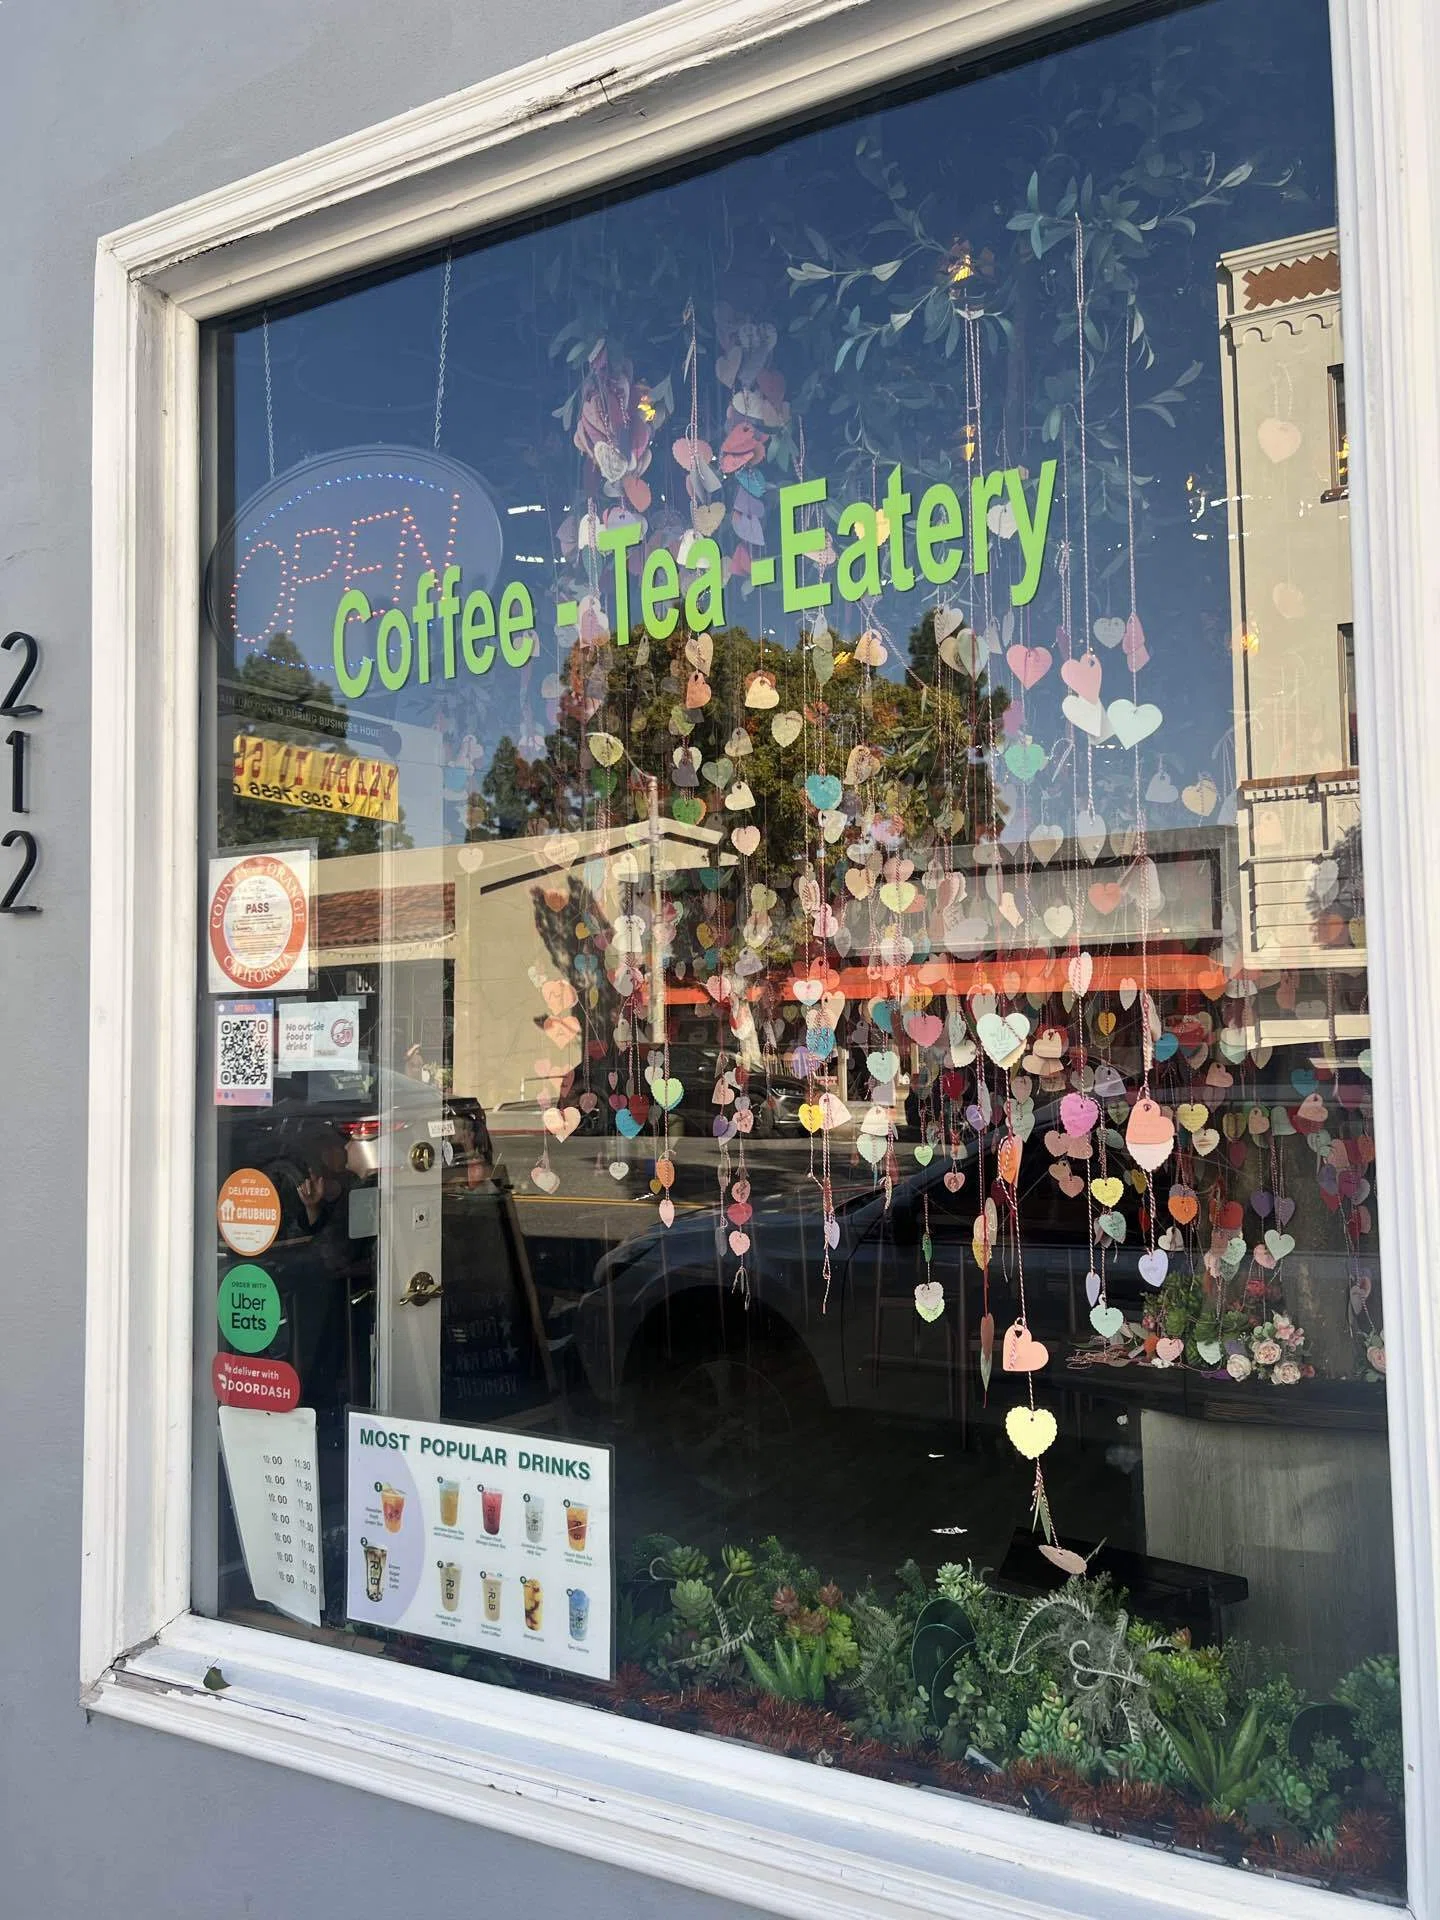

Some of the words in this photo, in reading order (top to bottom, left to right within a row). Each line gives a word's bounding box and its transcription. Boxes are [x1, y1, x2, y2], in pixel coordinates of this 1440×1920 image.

[333, 565, 534, 698] Coffee
[598, 523, 725, 646] Tea
[265, 862, 305, 923] ORANGE
[245, 902, 270, 915] PASS
[223, 951, 297, 984] CALIFORNIA
[286, 1023, 297, 1031] No
[298, 1021, 325, 1031] outside
[305, 1033, 313, 1041] or
[286, 1041, 308, 1051] drinks
[227, 1186, 271, 1197] DELIVERED
[236, 1207, 277, 1220] GRUBHUB
[231, 1292, 267, 1311] Uber
[231, 1312, 267, 1331] Eats
[232, 1365, 260, 1377] deliver
[261, 1370, 280, 1381] with
[227, 1379, 291, 1400] DOORDASH
[360, 1428, 410, 1451] MOST
[420, 1437, 507, 1467] POPULAR
[518, 1451, 592, 1481] DRINKS
